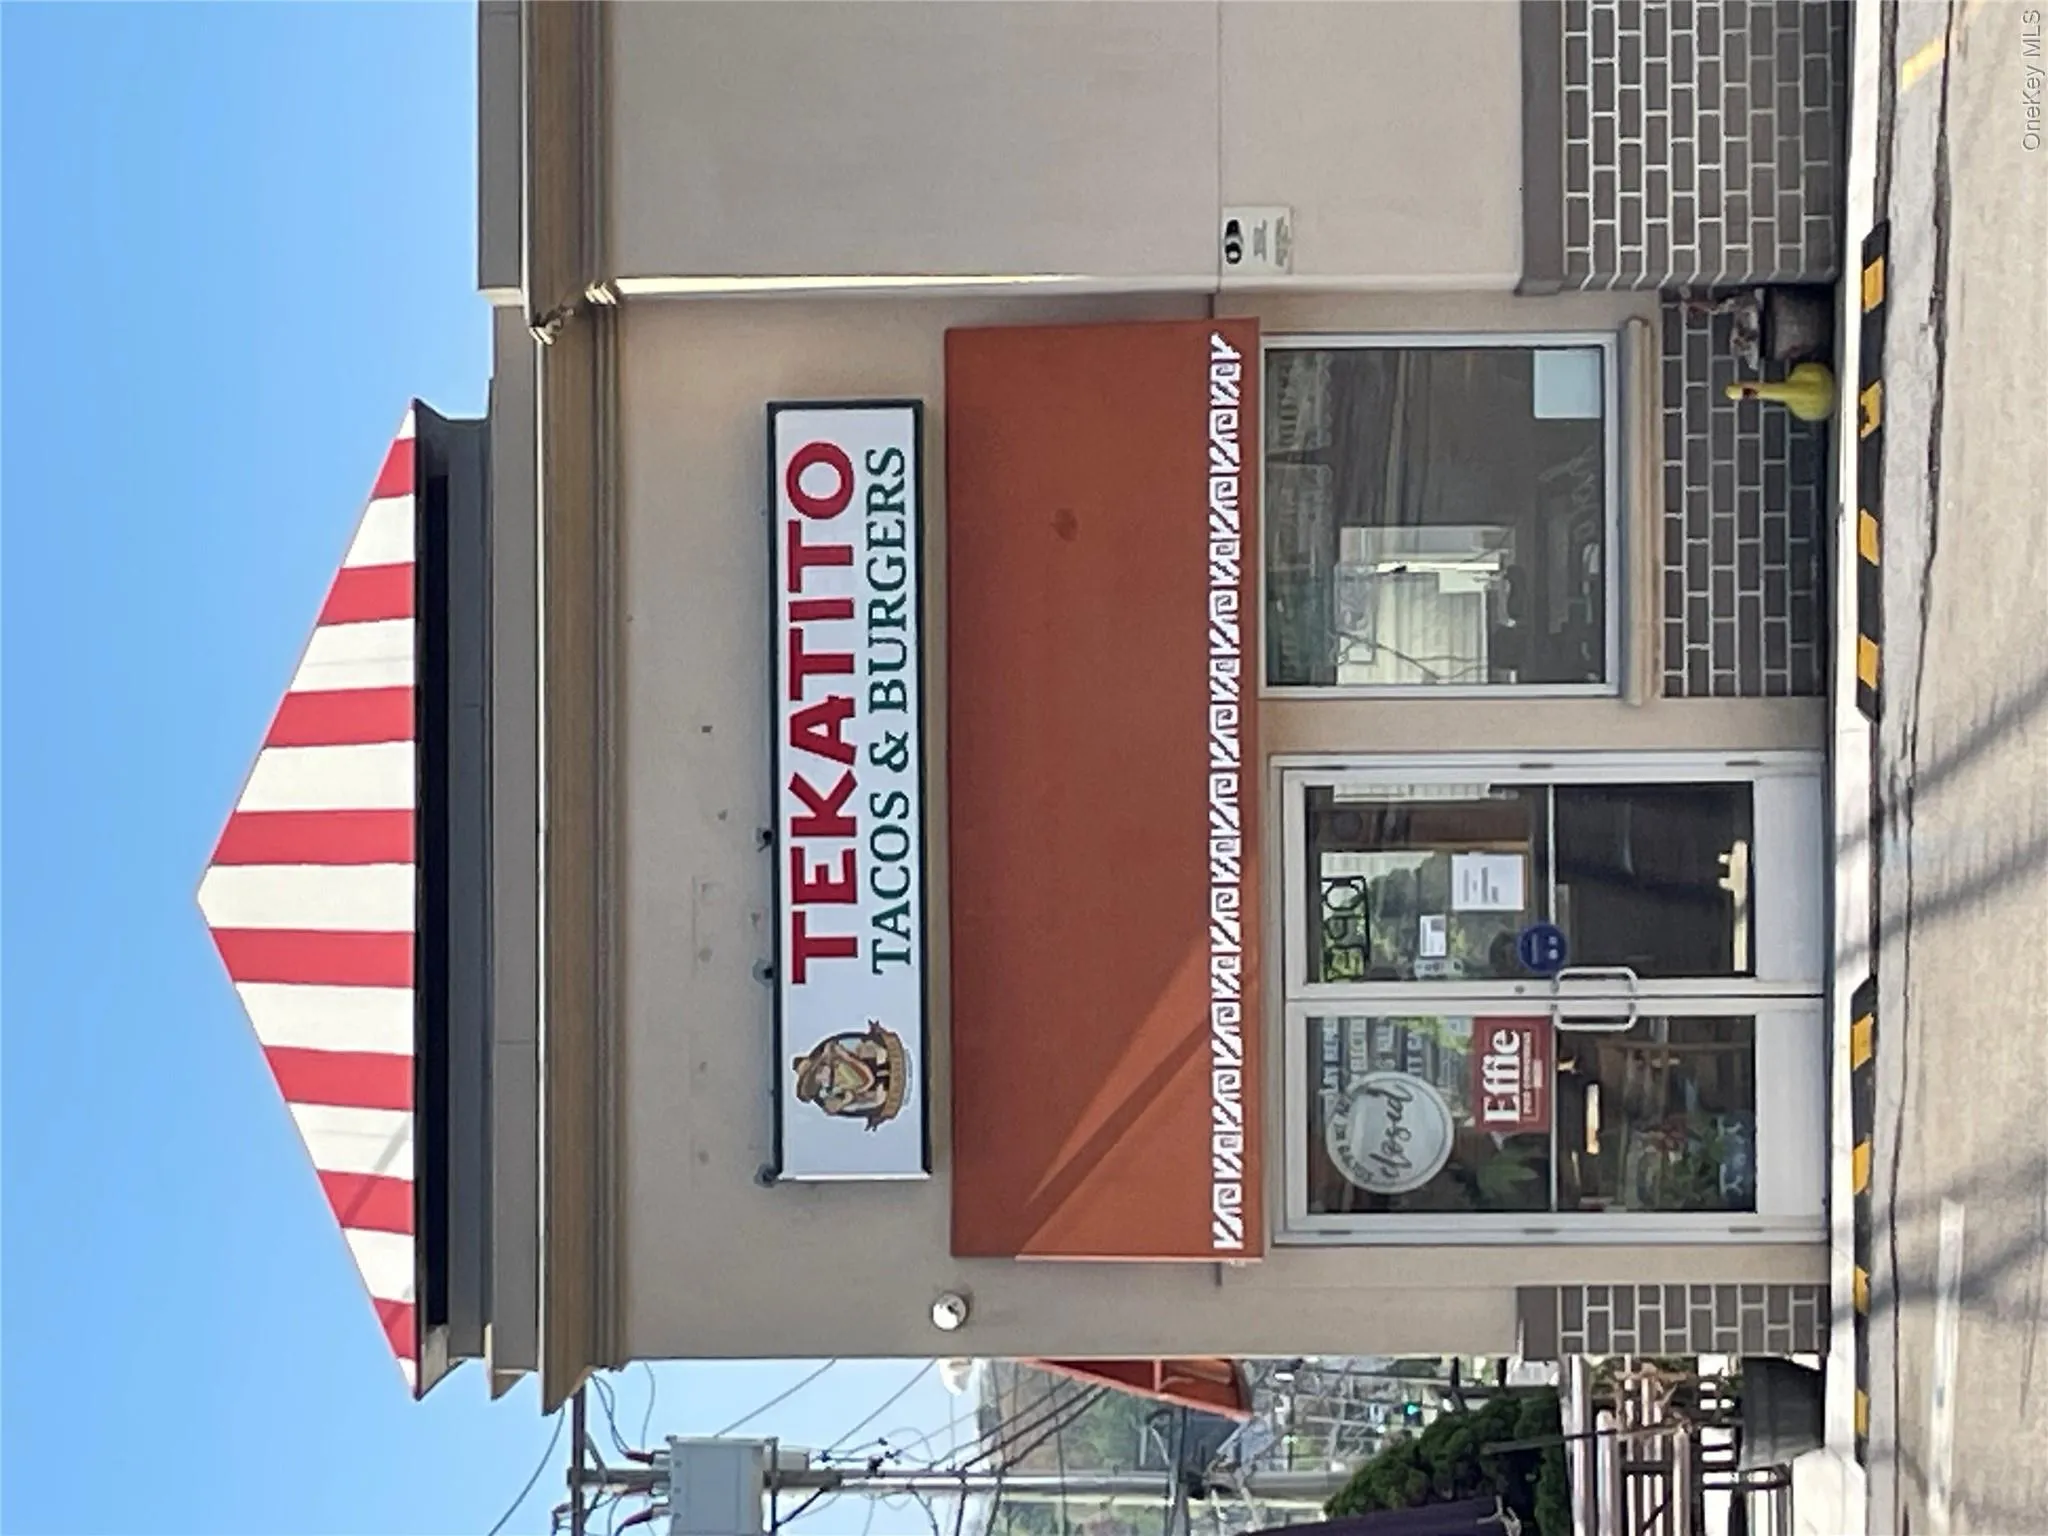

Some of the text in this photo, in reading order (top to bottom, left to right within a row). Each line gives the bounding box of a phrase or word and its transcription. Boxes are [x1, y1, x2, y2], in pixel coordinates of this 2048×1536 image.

[786, 442, 858, 984] TEKATITO
[865, 447, 910, 975] TACOS & BURGERS
[1361, 1084, 1413, 1179] closed
[1481, 1029, 1521, 1122] Effie
